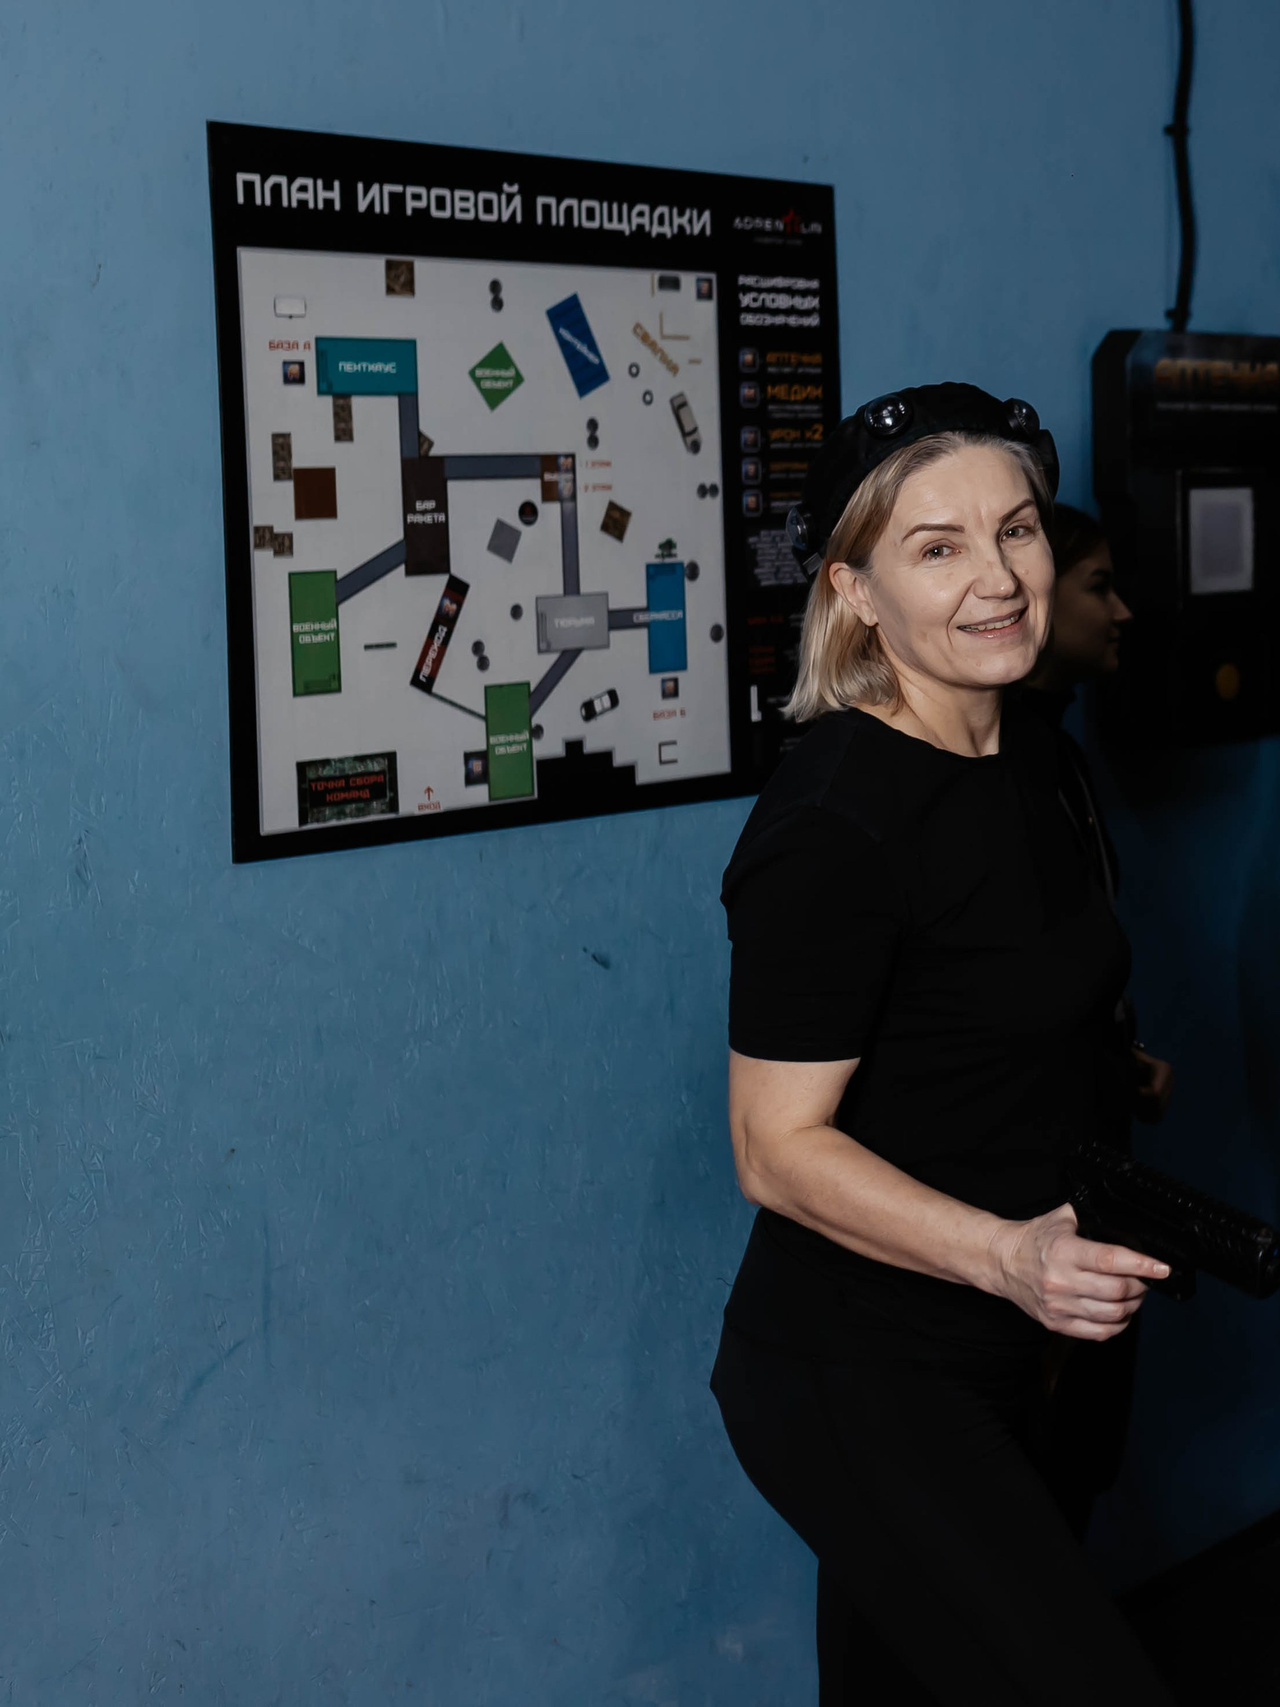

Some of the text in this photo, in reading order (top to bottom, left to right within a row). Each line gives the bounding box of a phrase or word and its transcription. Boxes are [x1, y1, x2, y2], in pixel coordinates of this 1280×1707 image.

[236, 172, 711, 239] ПЛАН ИГРОВОЙ ПЛОЩАДКИ
[739, 291, 820, 310] УСЛОВНЫХ
[268, 339, 299, 351] БАЗА
[338, 360, 397, 375] ПЕНТХАУС
[766, 383, 823, 401] МЕДИК
[415, 500, 436, 511] БАР
[407, 512, 446, 524] РАКЕТА
[293, 618, 337, 633] ВОЕННЫЙ
[419, 624, 448, 683] ПЕРЕХОД
[490, 729, 529, 745] ВОЕННЫЙ
[310, 774, 385, 792] ТОЧКА СБОРА
[326, 788, 370, 802] КОМАНД
